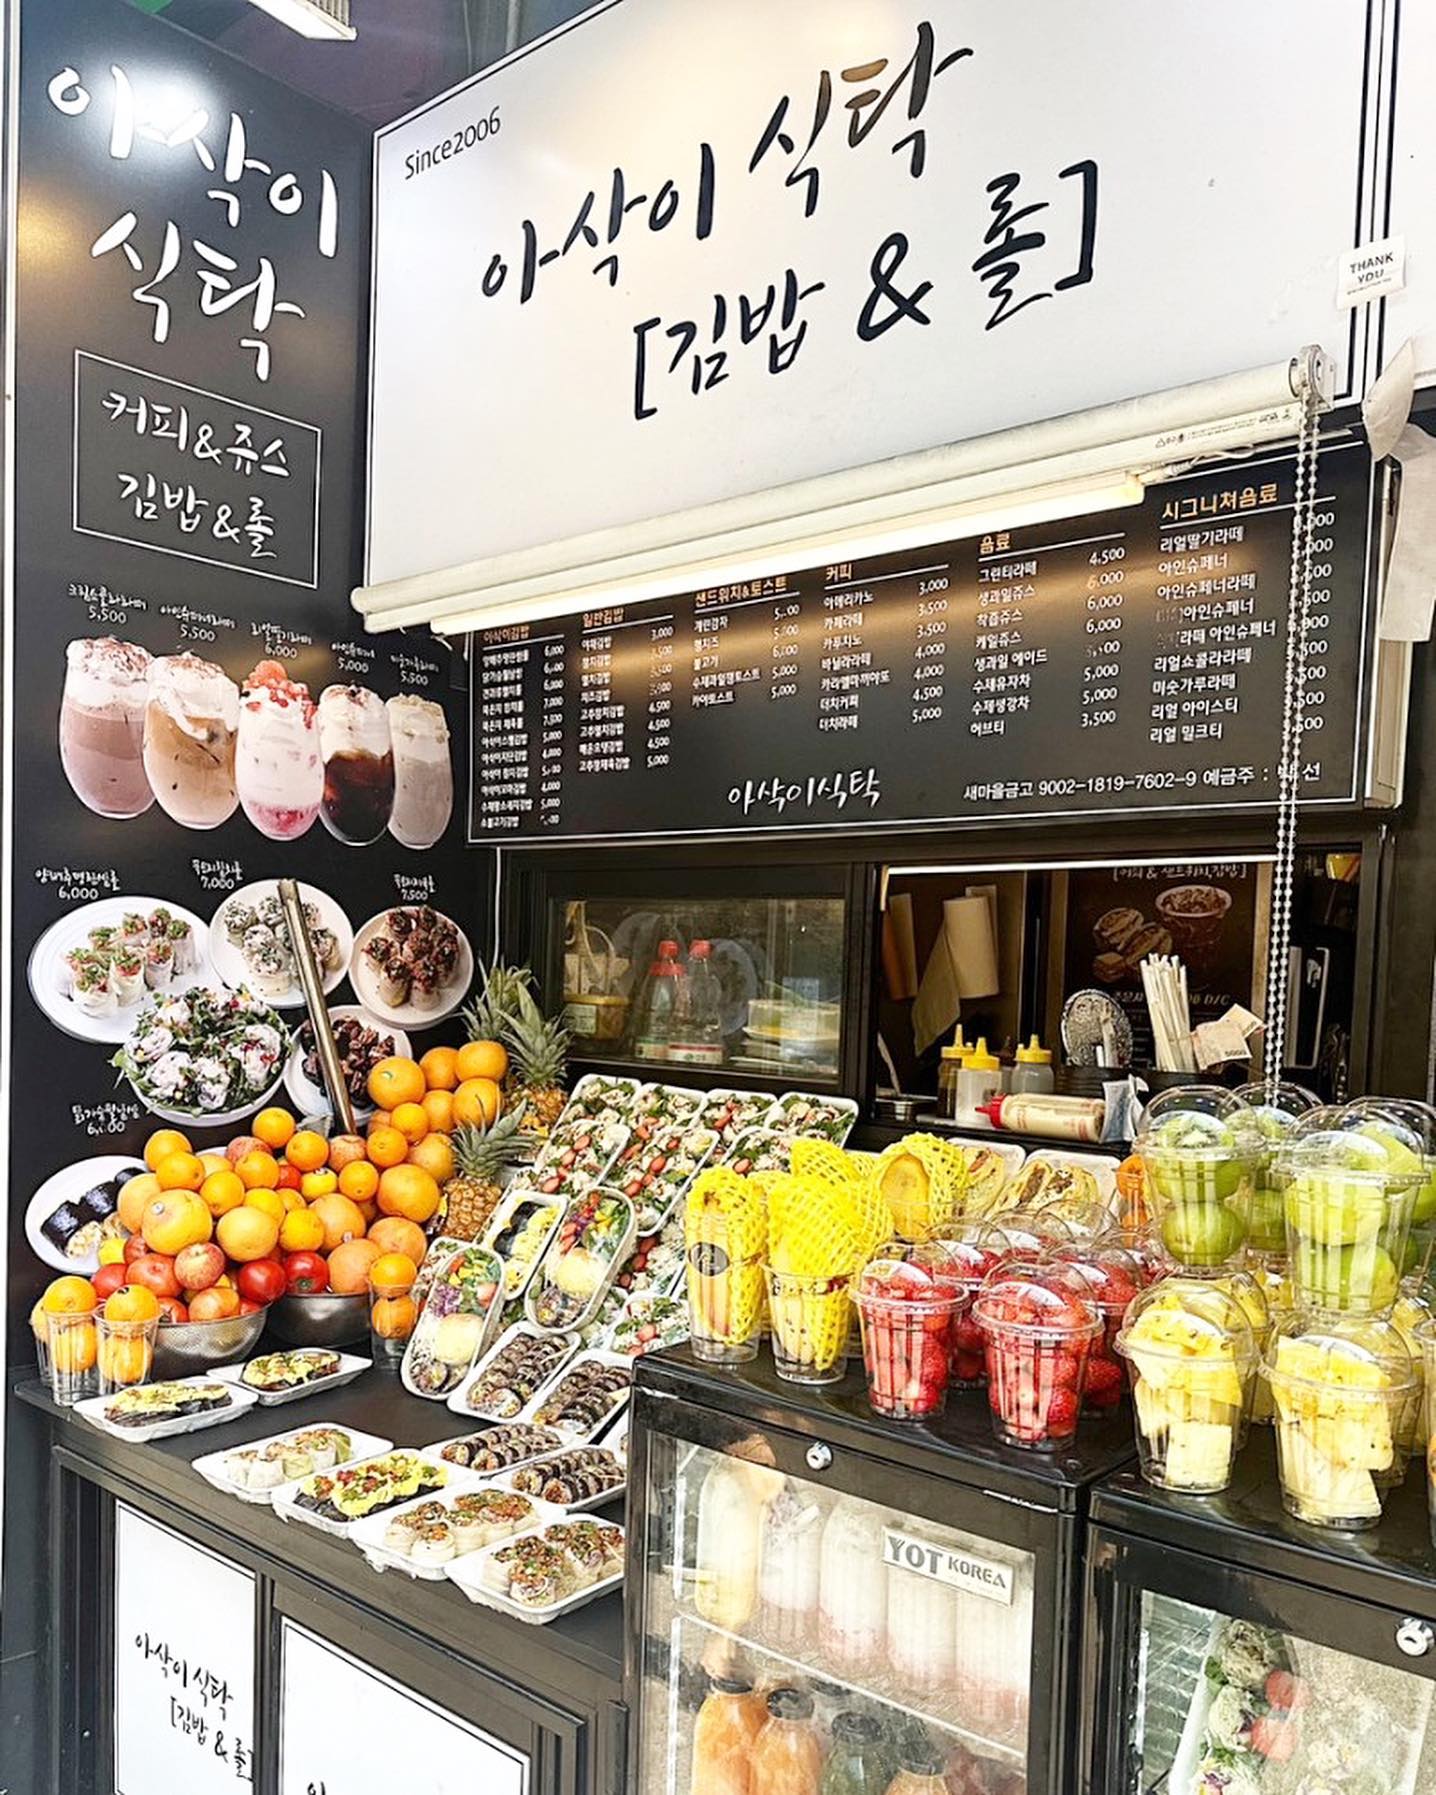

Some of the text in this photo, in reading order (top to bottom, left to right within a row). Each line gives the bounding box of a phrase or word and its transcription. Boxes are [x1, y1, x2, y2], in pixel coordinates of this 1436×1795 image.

[405, 107, 502, 181] Since2006
[482, 21, 973, 304] 아삭이 식탁
[1350, 252, 1394, 274] THANK
[1357, 268, 1385, 285] YOU
[857, 232, 933, 342] &
[92, 211, 305, 382] 식탁
[980, 532, 1011, 556] 음료
[1089, 546, 1125, 566] 4,500
[1158, 552, 1228, 577] 아인슈페너
[826, 563, 853, 581] 커피
[823, 577, 949, 610] 아메리카노 3,000
[1157, 573, 1256, 601] 아인슈페너라떼
[918, 600, 948, 617] 3,500
[1087, 594, 1123, 612] 6,000
[88, 605, 127, 624] 5,500
[180, 624, 216, 642] 5,500
[916, 622, 947, 639] 3,500
[1086, 617, 1122, 635] 6,000
[1208, 619, 1277, 642] 아인슈페너
[265, 644, 297, 659] 6,000
[914, 642, 945, 660] 4,000
[1011, 648, 1048, 668] 에이드
[338, 658, 370, 674] 5,000
[913, 664, 944, 681] 4,000
[1083, 664, 1119, 682] 5,000
[770, 684, 798, 701] 5,000
[912, 685, 944, 703] 4,500
[1082, 687, 1118, 705] 5,000
[911, 706, 942, 724] 5,000
[1152, 702, 1180, 722] 리얼
[1181, 697, 1240, 719] 아이스티
[1081, 710, 1117, 728] 3,500
[1150, 726, 1178, 745] 리얼
[963, 782, 1034, 801] 새마을금고
[1038, 769, 1197, 796] 9002-1819-7602-9
[1203, 765, 1256, 786] 예금주
[200, 875, 235, 890] 7,000
[58, 885, 99, 900] 6,000
[888, 1535, 1006, 1589] YOT KOREA
[135, 1632, 233, 1721] 아삭이 식탁
[214, 1730, 229, 1763] &
